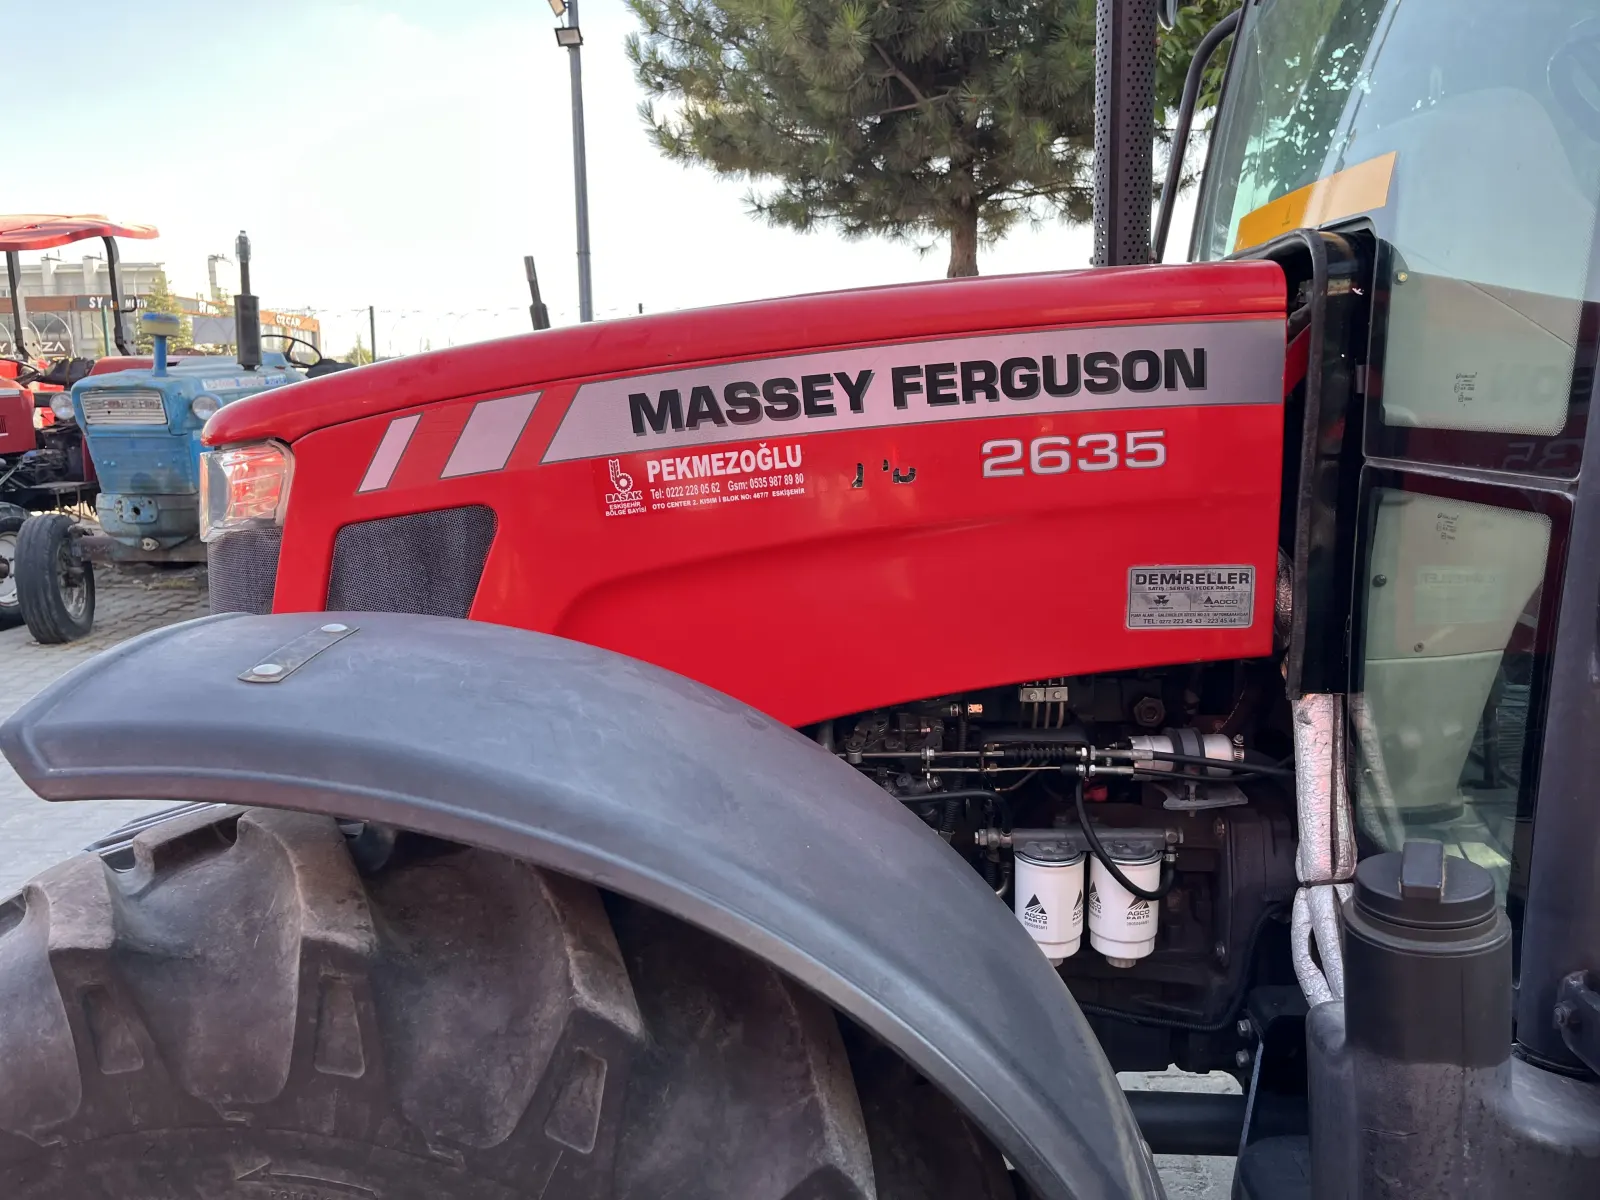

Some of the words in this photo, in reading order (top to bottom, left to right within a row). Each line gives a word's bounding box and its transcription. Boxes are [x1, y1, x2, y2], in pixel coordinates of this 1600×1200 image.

[628, 369, 876, 437] MASSEY
[891, 347, 1208, 410] FERGUSON
[981, 429, 1168, 479] 2635
[646, 442, 803, 483] PEKMEZOĞLU
[650, 487, 665, 501] Tel:
[666, 486, 684, 499] 0222
[685, 484, 699, 497] 228
[700, 483, 710, 495] 05
[710, 482, 721, 494] 62
[728, 480, 748, 492] Gsm:
[749, 476, 768, 489] 0535
[769, 475, 782, 487] 987
[783, 474, 794, 486] 89
[794, 472, 805, 485] 80
[666, 500, 692, 509] CENTER
[1135, 570, 1250, 586] DEMİRELLER
[1024, 911, 1048, 921] AGCO
[1024, 916, 1048, 925] PARTS
[1127, 909, 1150, 917] AGCO
